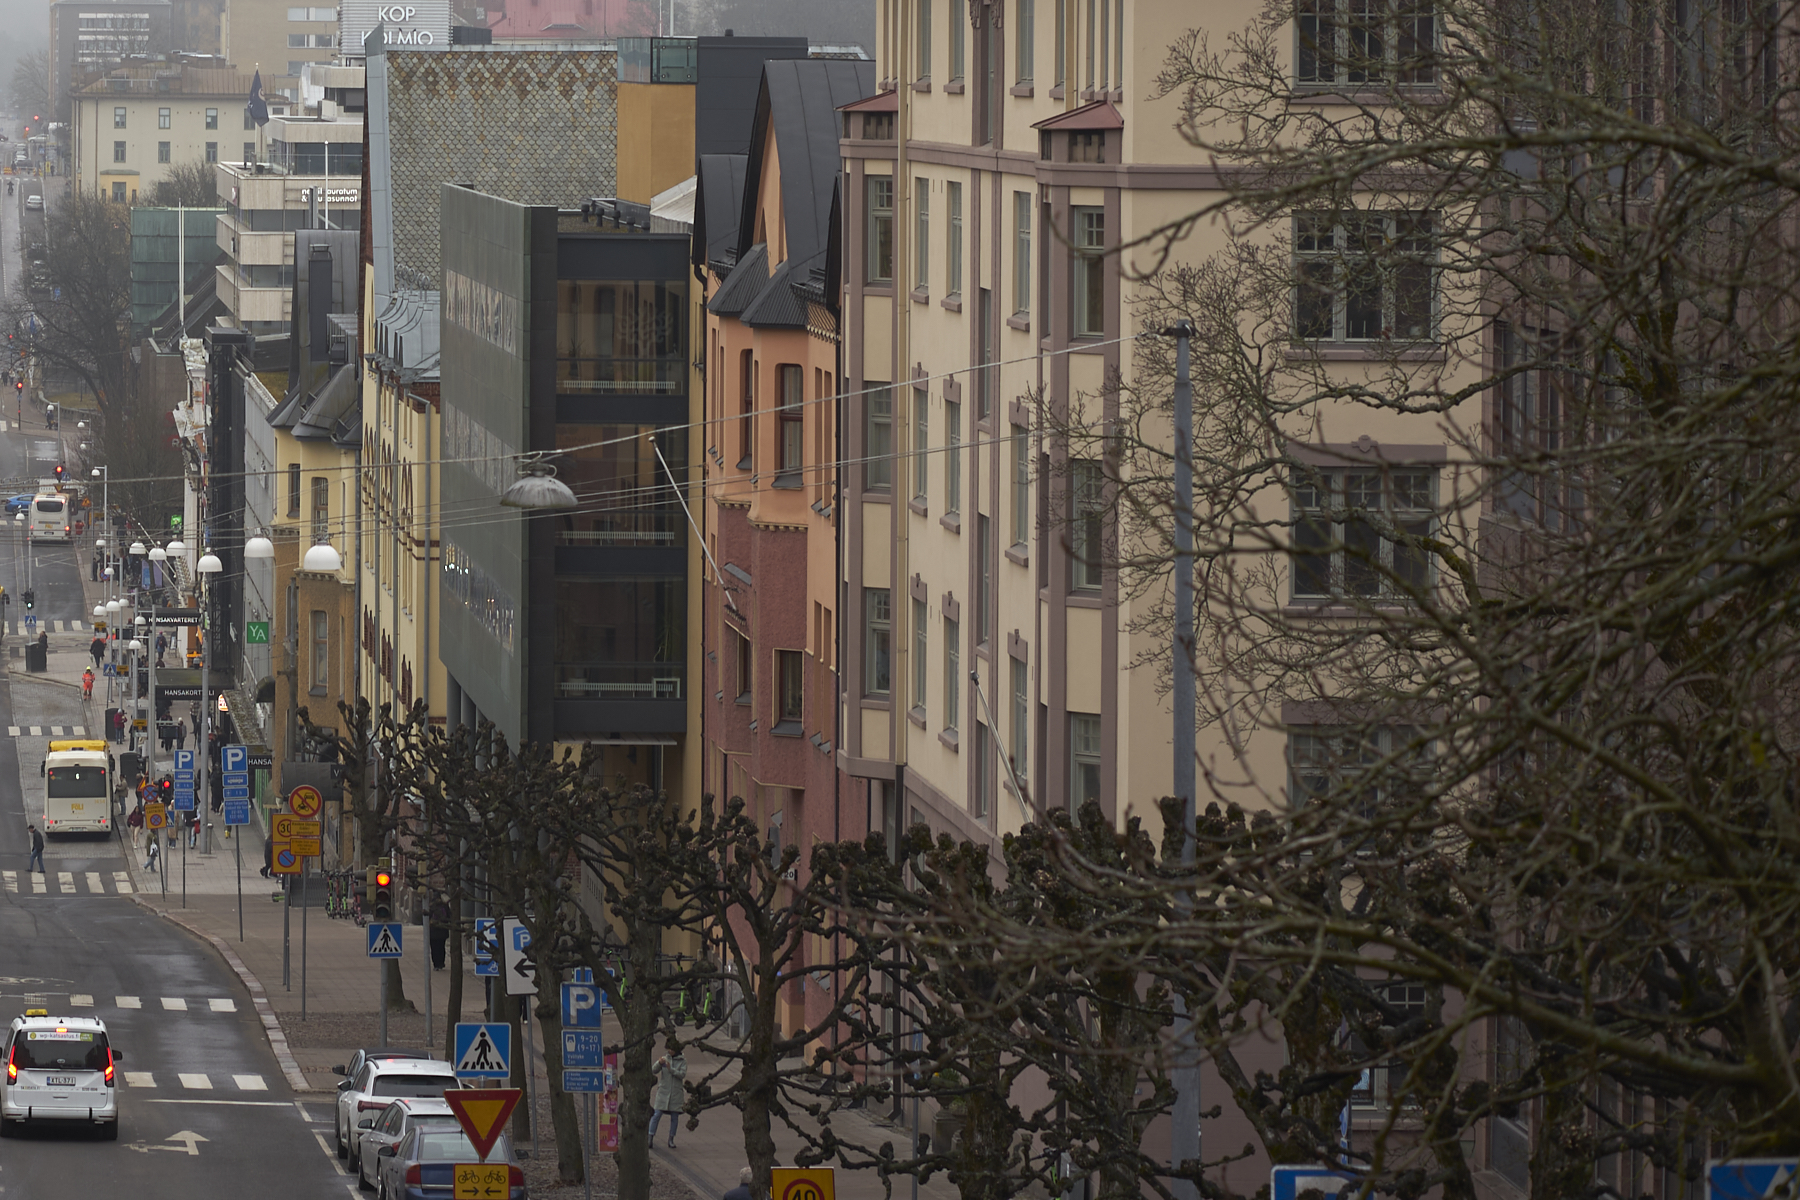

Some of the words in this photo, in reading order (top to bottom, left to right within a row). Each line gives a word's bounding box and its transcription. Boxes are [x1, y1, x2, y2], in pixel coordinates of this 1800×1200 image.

[378, 6, 416, 22] KOP
[361, 30, 434, 46] KLMIO
[249, 625, 267, 641] YA
[178, 751, 192, 769] P
[227, 748, 244, 771] P
[520, 934, 531, 948] P
[569, 986, 596, 1025] P
[580, 1034, 598, 1043] 9-20
[577, 1044, 600, 1052] (9-17)
[594, 1055, 598, 1064] 1
[593, 1077, 599, 1086] A
